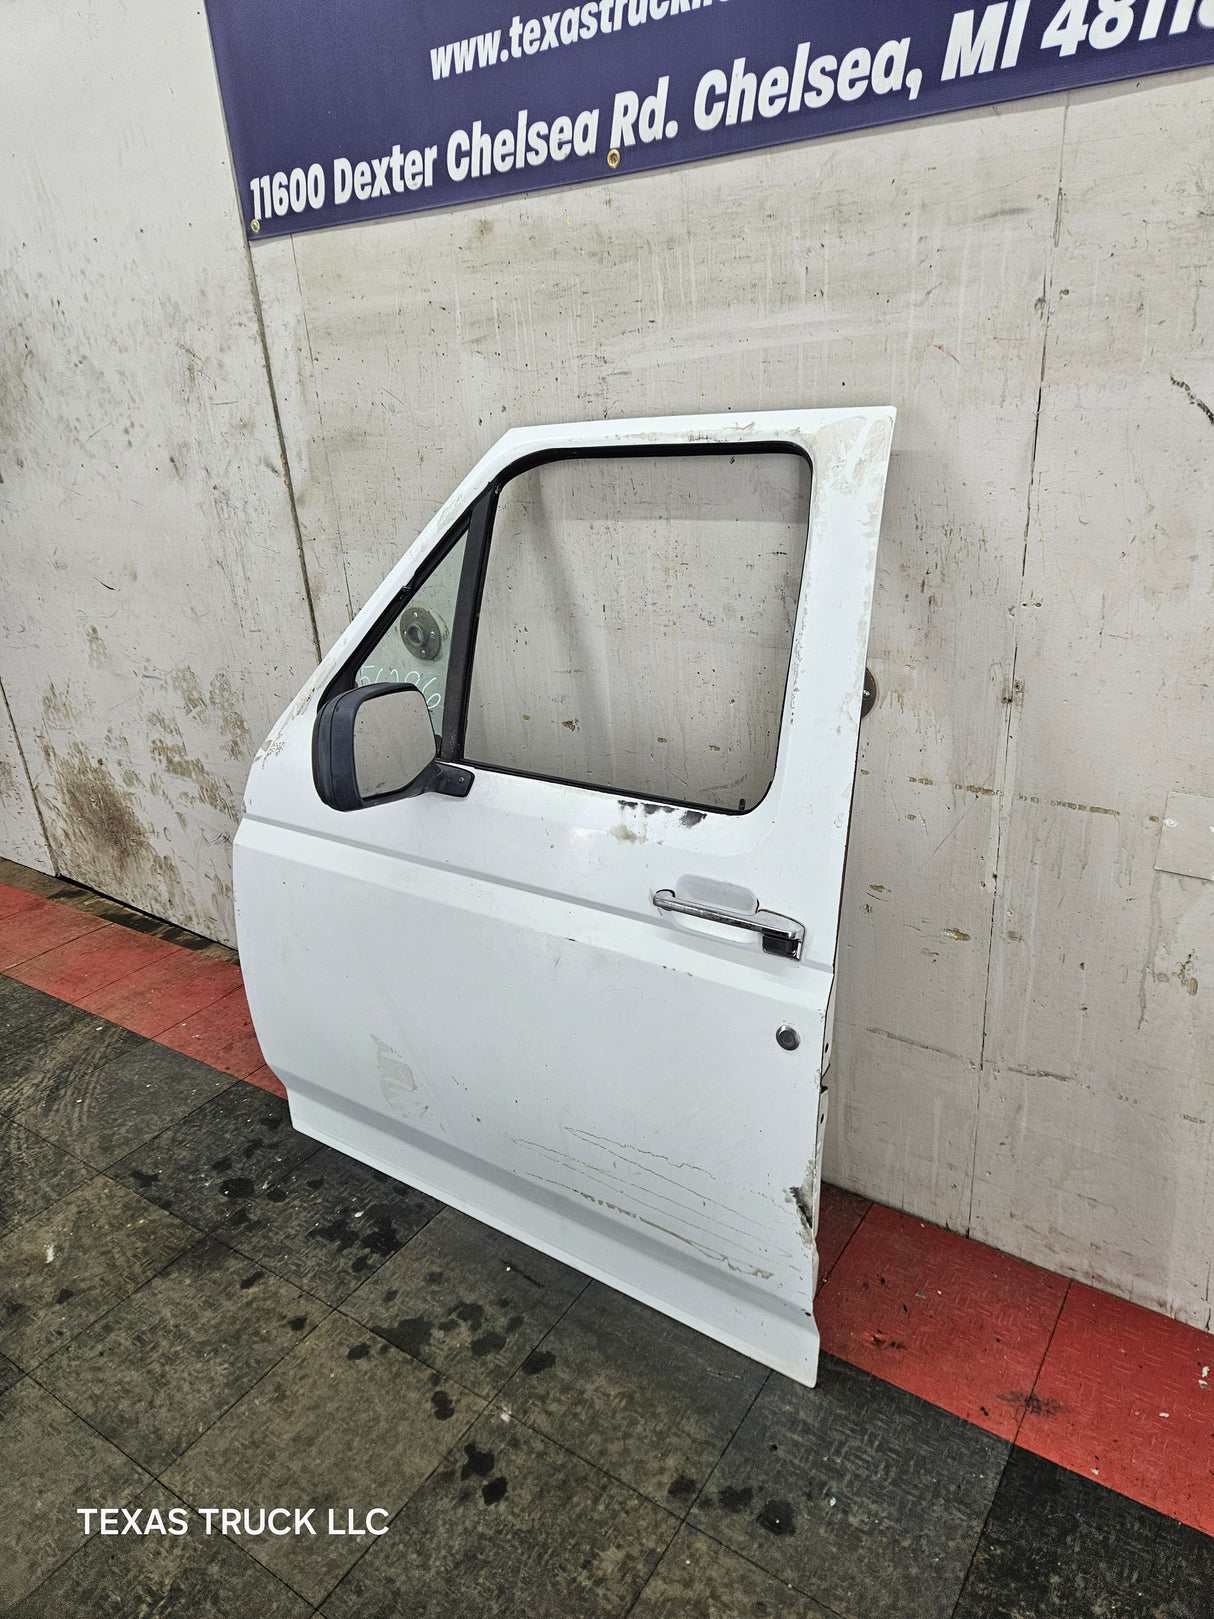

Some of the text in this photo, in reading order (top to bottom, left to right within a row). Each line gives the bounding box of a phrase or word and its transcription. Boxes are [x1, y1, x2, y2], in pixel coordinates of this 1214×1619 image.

[250, 0, 1214, 219] 11600 Dexter Chelsea Rd. Chelsea, MI 481
